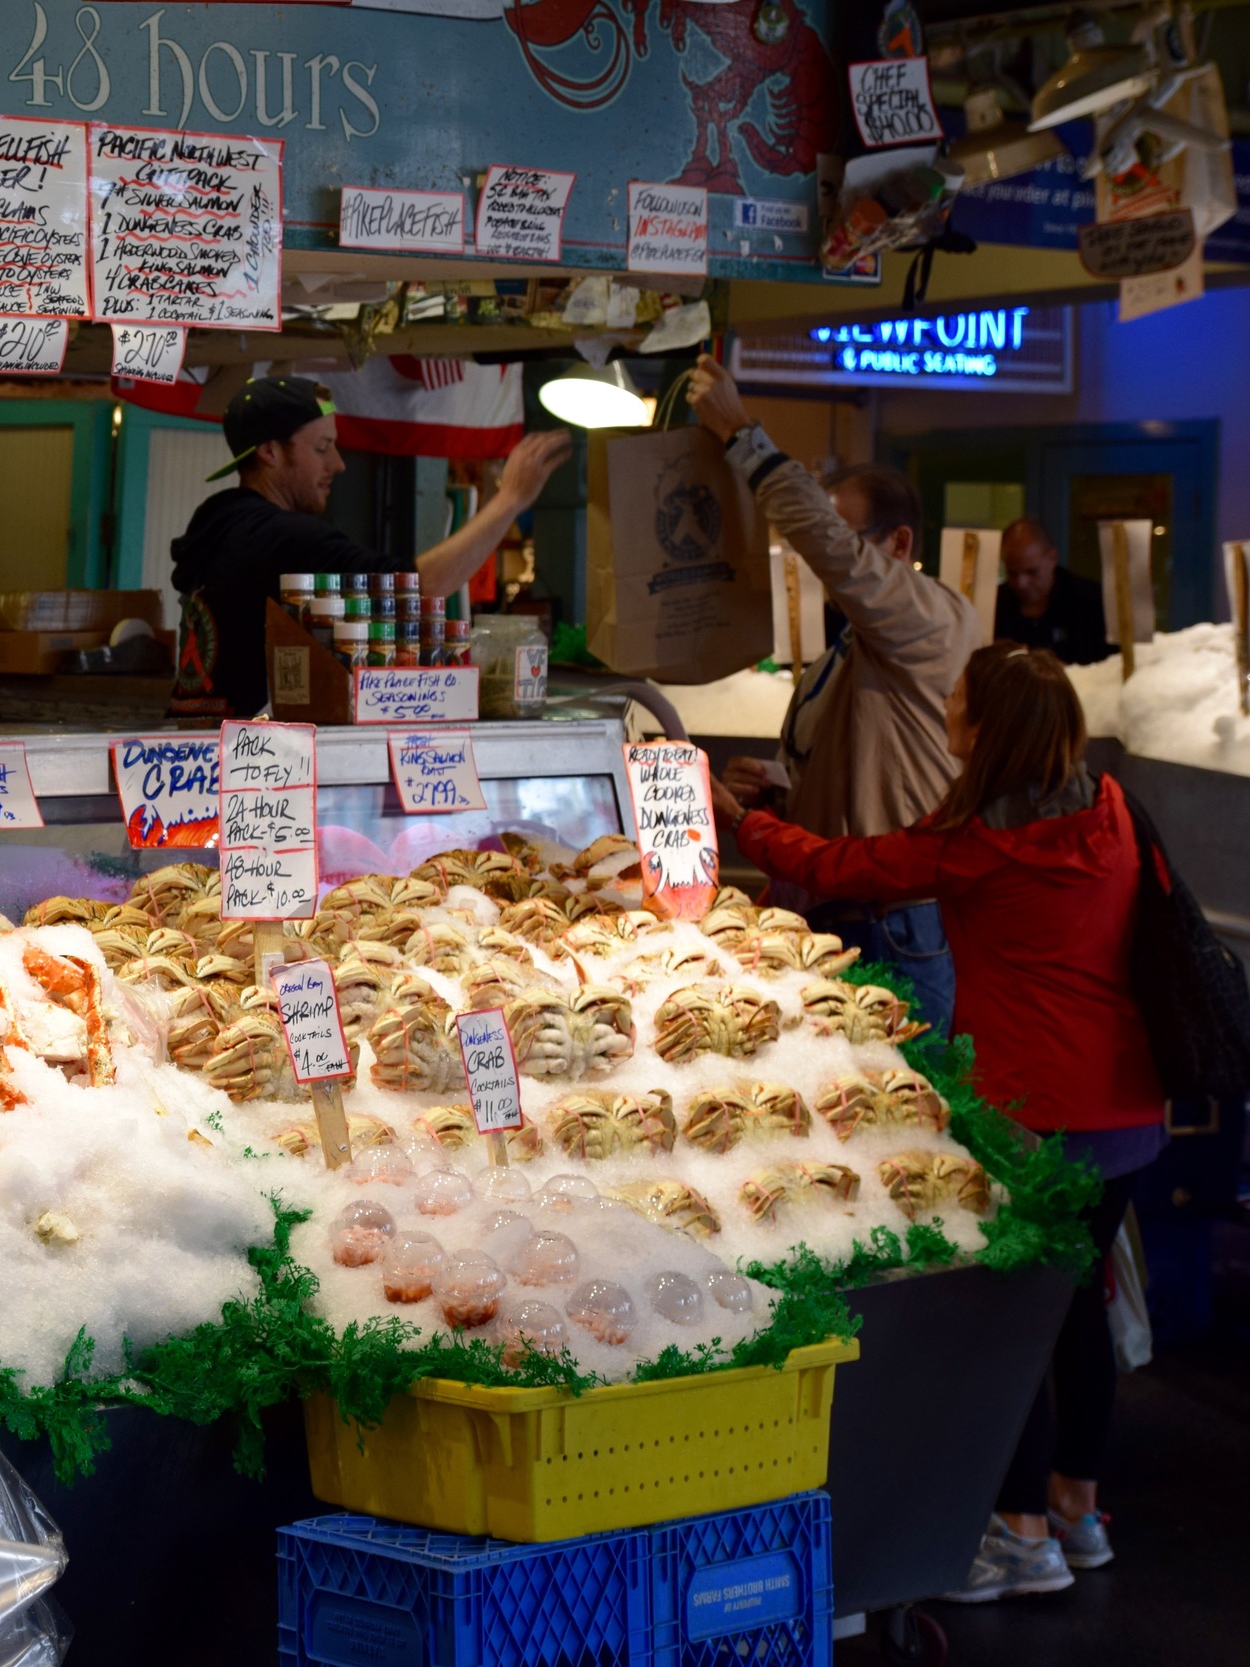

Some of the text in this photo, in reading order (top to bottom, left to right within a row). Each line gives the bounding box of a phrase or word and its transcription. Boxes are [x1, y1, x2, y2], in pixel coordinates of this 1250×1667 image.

[8, 0, 110, 111] 48
[139, 8, 382, 143] hours
[860, 64, 908, 92] CHEF
[854, 91, 928, 117] SPECIAL
[180, 193, 244, 213] SALMON
[115, 212, 243, 242] DUNGENESS CRAB
[761, 214, 802, 228] Facebook
[172, 260, 234, 278] SALMON
[860, 350, 996, 377] PUBLIC SEATING
[233, 728, 276, 758] PACK
[230, 767, 261, 780] TO
[639, 766, 685, 784] WHOLE
[643, 784, 696, 804] COOKED
[639, 804, 710, 831] DUNGENESS
[652, 829, 690, 848] CRAB
[281, 995, 334, 1027] SHRIMP
[459, 1027, 505, 1050] DUNGENESS
[467, 1046, 505, 1076] CRAB
[693, 1575, 790, 1607] SMITH BROTHERS FARMS
